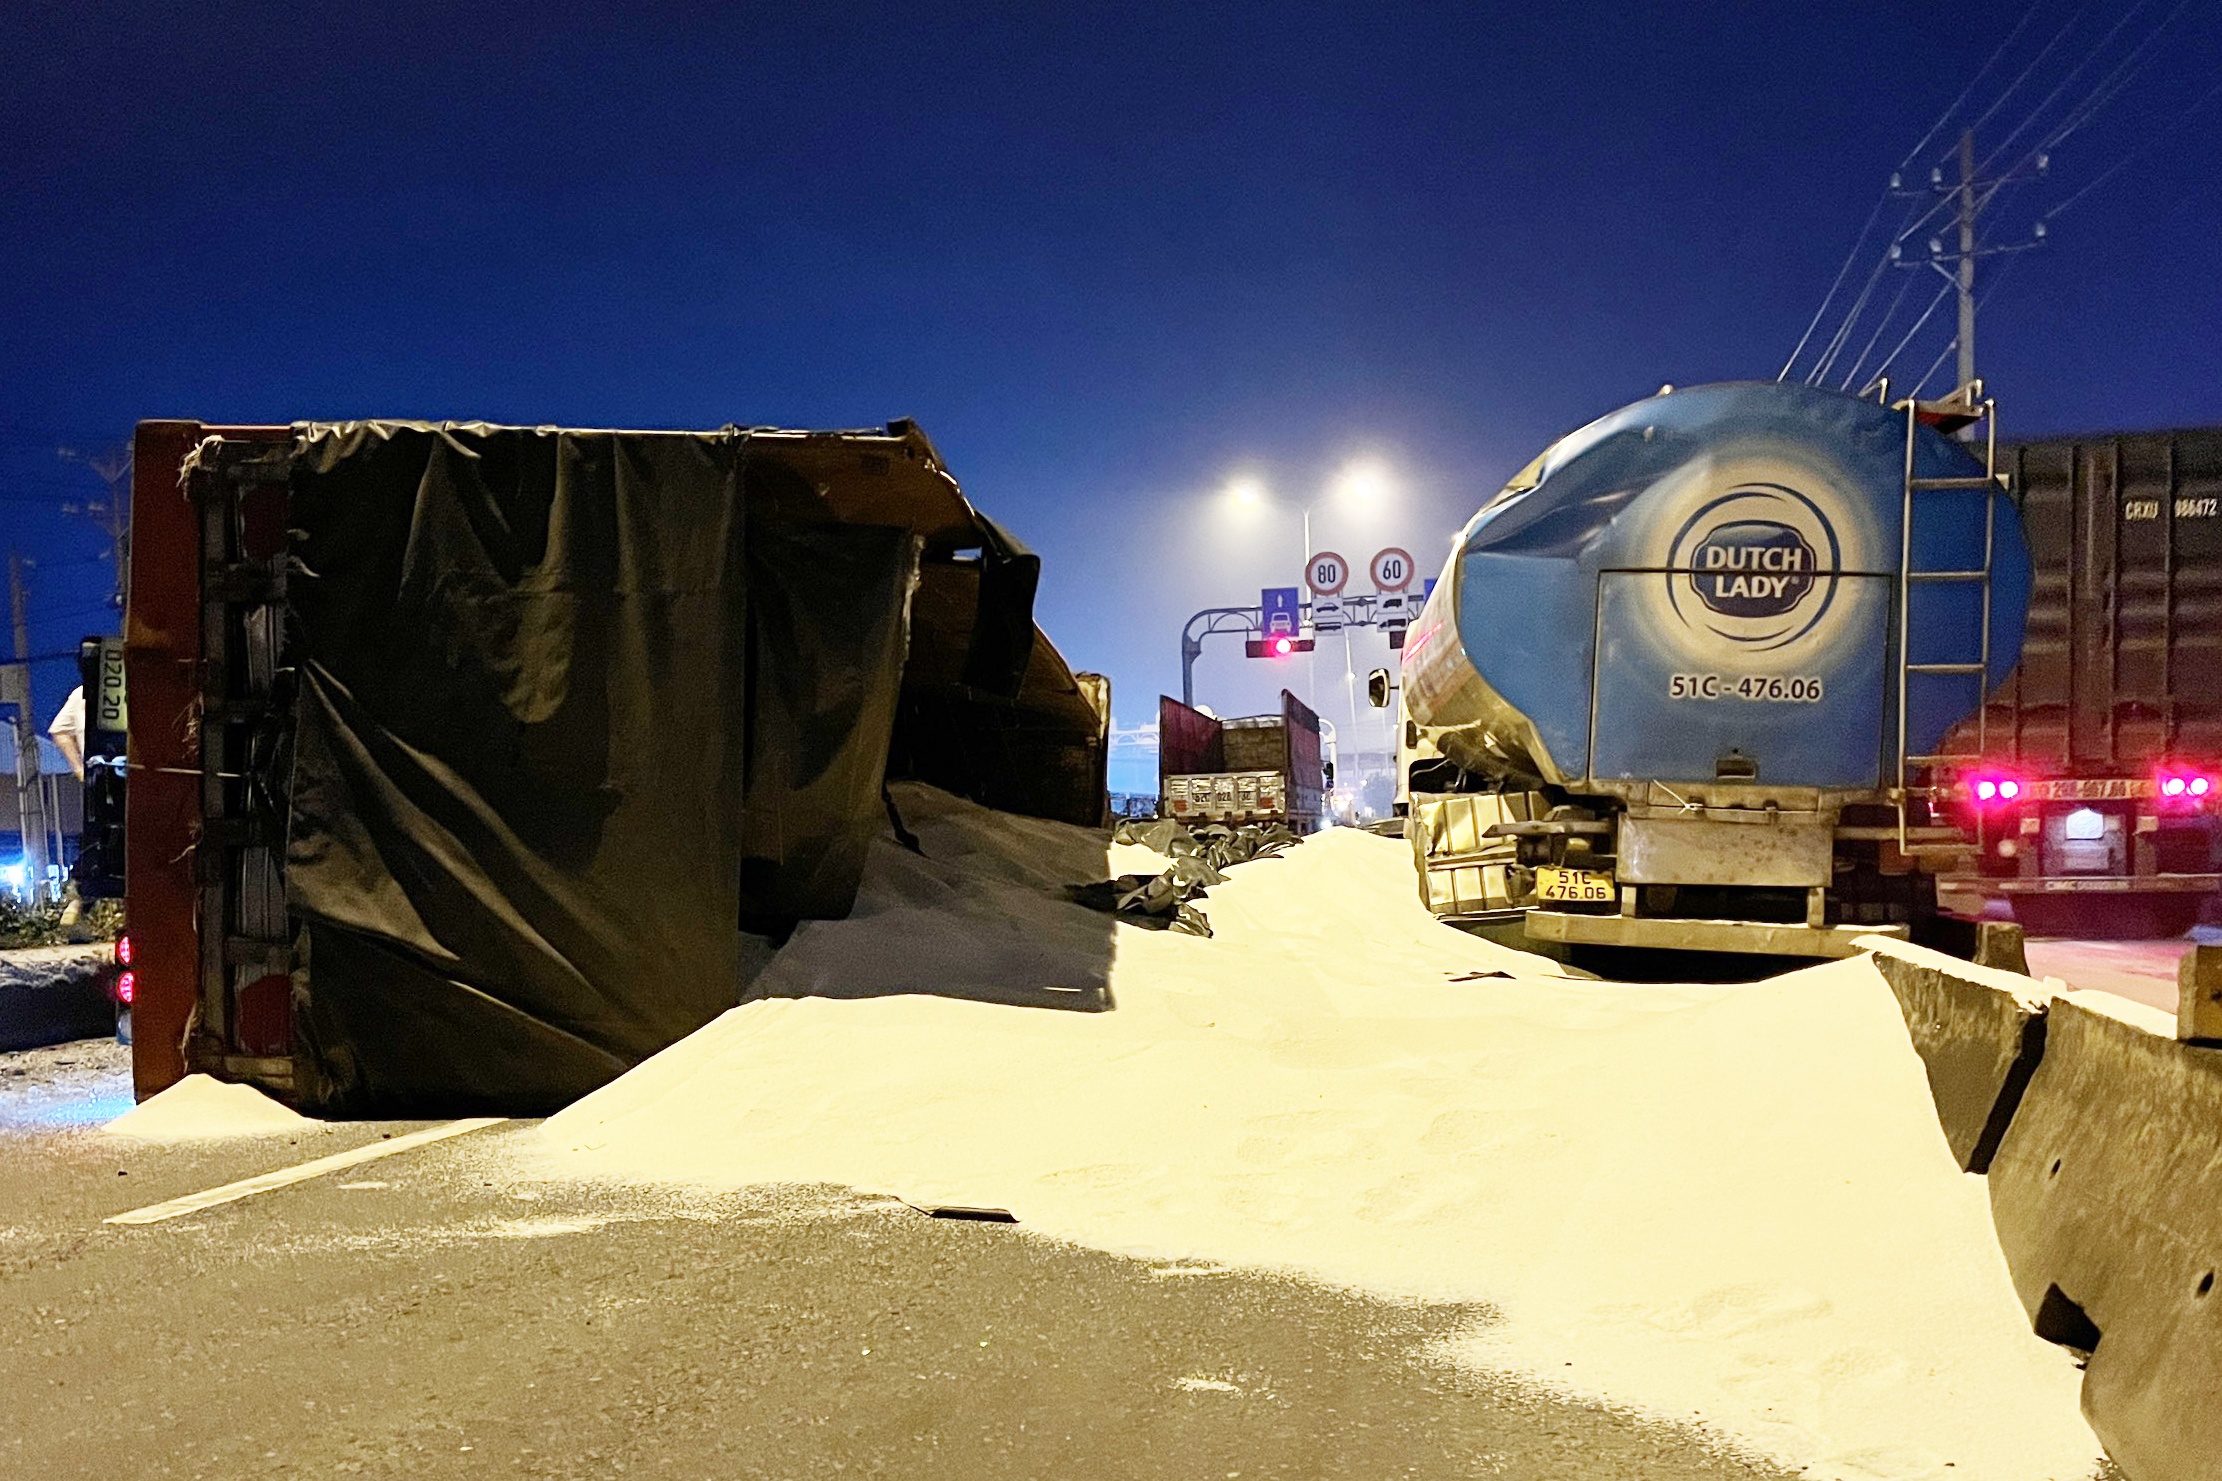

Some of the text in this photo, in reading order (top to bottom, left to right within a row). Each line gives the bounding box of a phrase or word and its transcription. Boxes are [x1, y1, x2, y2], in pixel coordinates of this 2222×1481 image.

[1382, 559, 1402, 580] 60
[1705, 546, 1802, 573] DUTCH
[1317, 564, 1336, 584] 80
[1715, 575, 1787, 598] LADY
[102, 649, 122, 720] 020.20
[1670, 675, 1719, 698] 51C
[1738, 677, 1821, 699] 476.06
[1558, 871, 1592, 885] 51C
[1545, 885, 1606, 899] 476.06
